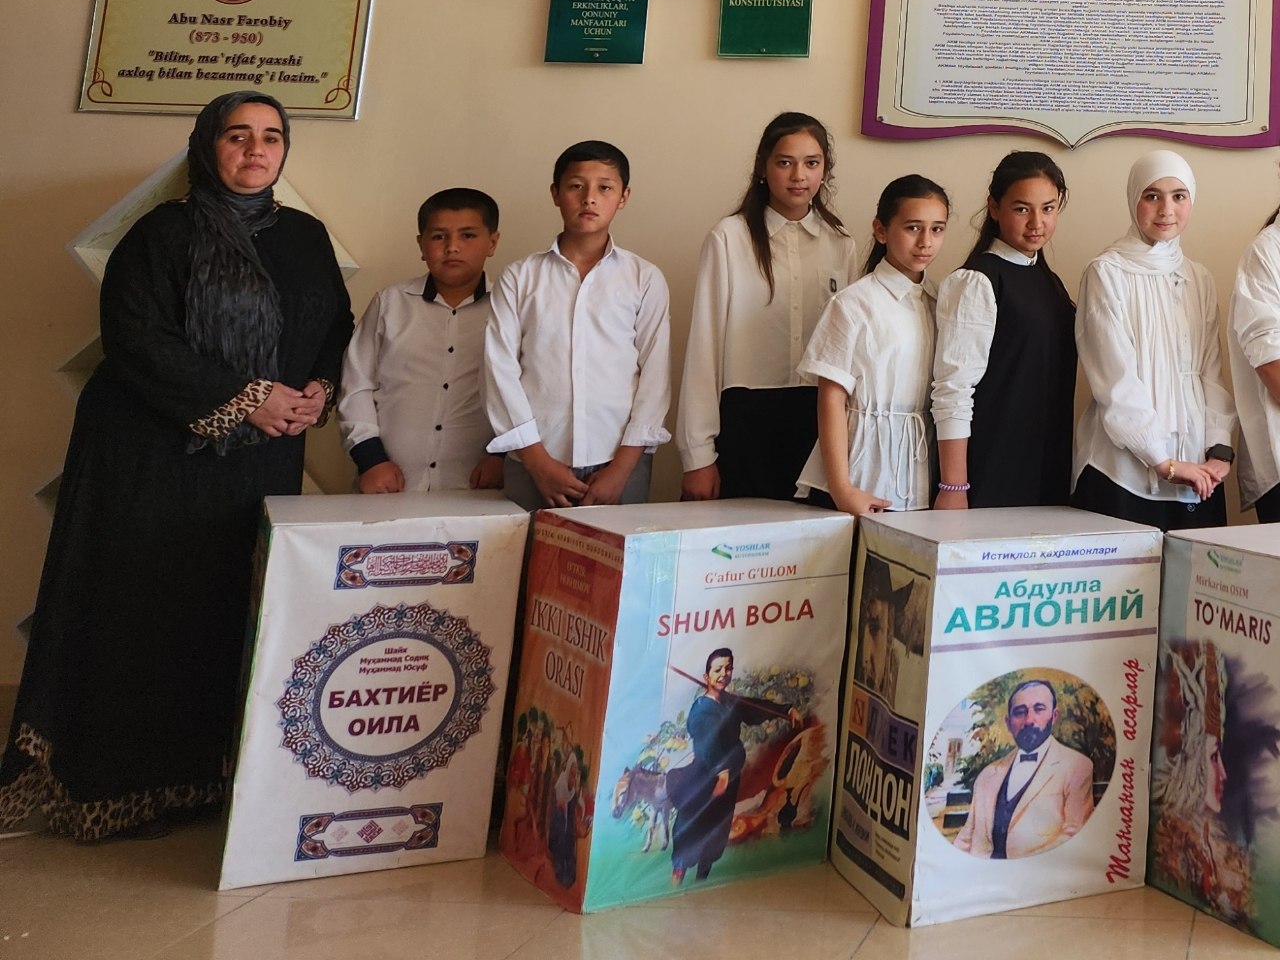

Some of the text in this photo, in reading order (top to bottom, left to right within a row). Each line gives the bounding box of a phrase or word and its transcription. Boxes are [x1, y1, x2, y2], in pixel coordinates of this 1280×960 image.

[168, 13, 292, 30] Abu Nasr Farobiy
[570, 19, 627, 27] MANFAATLARI
[581, 10, 618, 18] QONUNIY
[188, 30, 220, 44] (873
[231, 31, 264, 46] 950)
[584, 28, 612, 36] UCHUN
[148, 50, 194, 66] "Bilim,
[258, 54, 303, 68] yaxshi
[117, 68, 154, 82] axloq
[158, 68, 192, 80] bilan
[278, 71, 328, 84] lozim."
[735, 543, 770, 552] YOSHLAR
[981, 544, 1118, 562] Истиқлол қаҳрамонлари
[994, 577, 1102, 601] Абдулла
[1196, 574, 1249, 599] Mirkarim OSIM
[657, 598, 814, 638] SHUM BOLA
[944, 588, 1144, 634] АВЛОНИЙ
[530, 597, 608, 664] IKKI ESHIK
[384, 646, 408, 654] Шайх
[360, 654, 430, 665] Муҳаммад Содиқ
[358, 663, 428, 676] Муҳаммад Юсуф
[545, 652, 586, 700] ORASI
[328, 681, 448, 709] БАХТИЁР
[348, 714, 420, 737] ОИЛА
[1106, 657, 1141, 885] Танланган асарлар
[846, 740, 913, 832] ЛОНДОН
